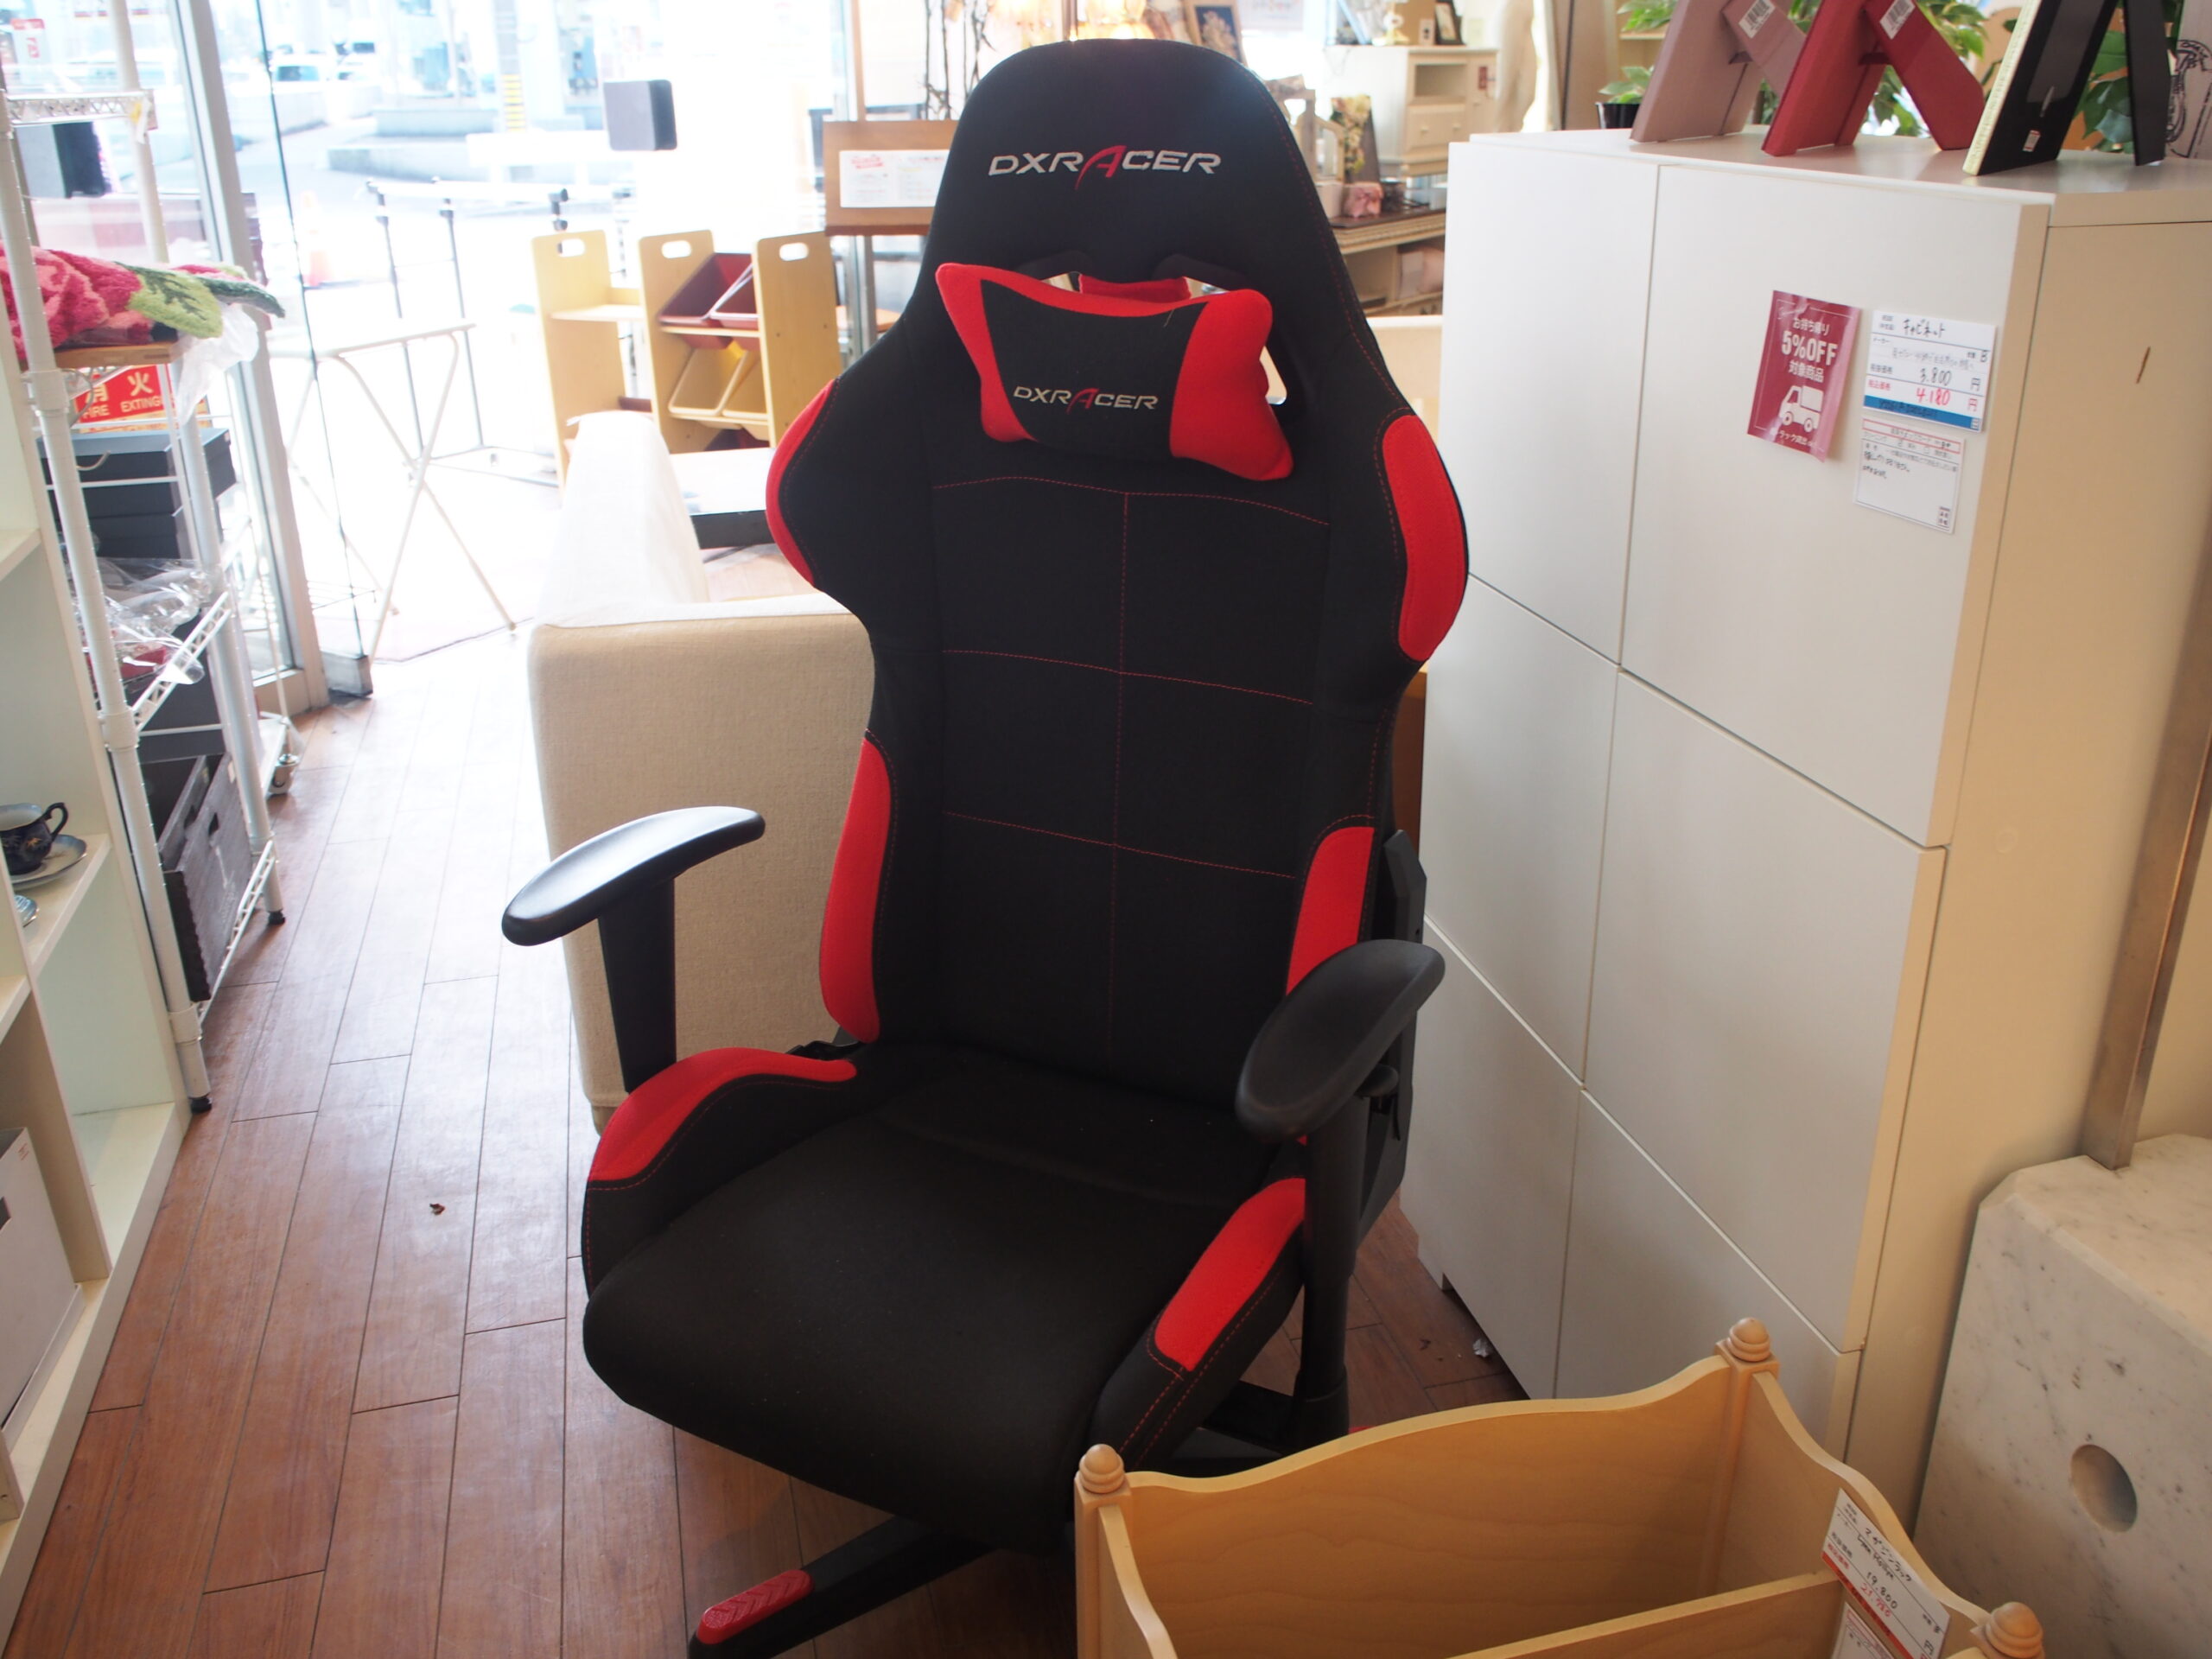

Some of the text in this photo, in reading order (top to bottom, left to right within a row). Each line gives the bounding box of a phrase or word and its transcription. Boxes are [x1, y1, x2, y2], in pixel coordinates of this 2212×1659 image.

[988, 145, 1221, 190] DXRACER
[1793, 317, 1829, 336] お持ち帰り
[1782, 330, 1838, 365] 5%OFF
[1789, 359, 1824, 383] 対象商品
[120, 395, 163, 413] EXTING
[1014, 386, 1159, 415] DXRACER
